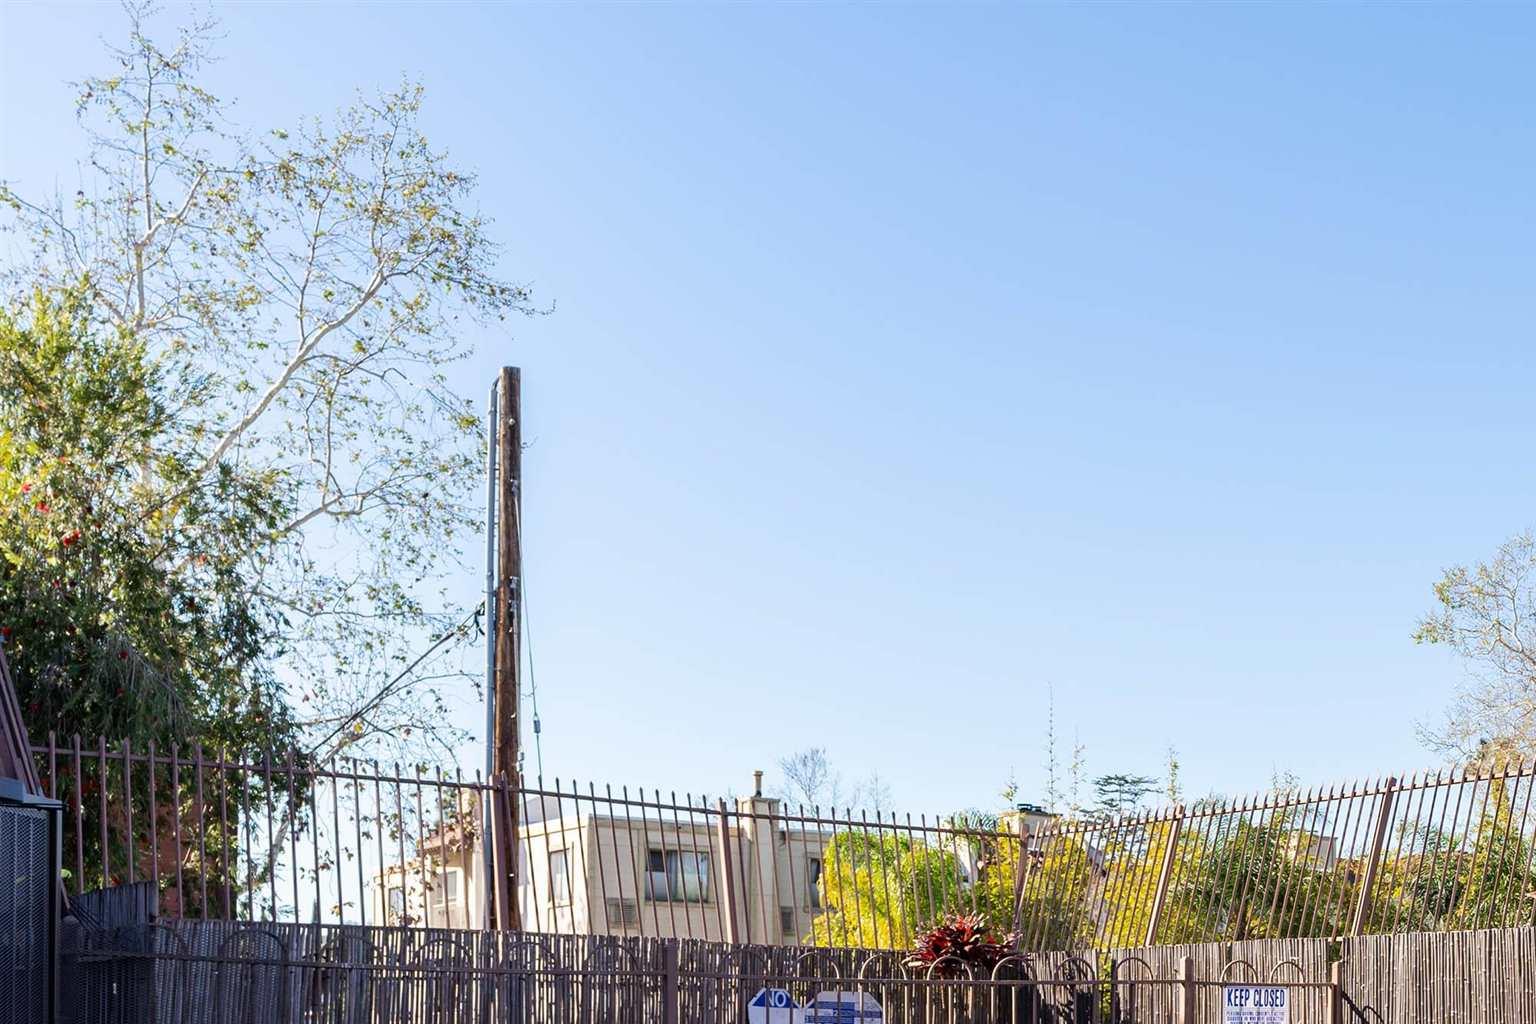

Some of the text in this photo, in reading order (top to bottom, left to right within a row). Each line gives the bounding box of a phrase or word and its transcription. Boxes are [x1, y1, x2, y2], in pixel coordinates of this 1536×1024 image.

[768, 990, 787, 1007] NO
[1227, 988, 1285, 1007] KEEP CLOSED
